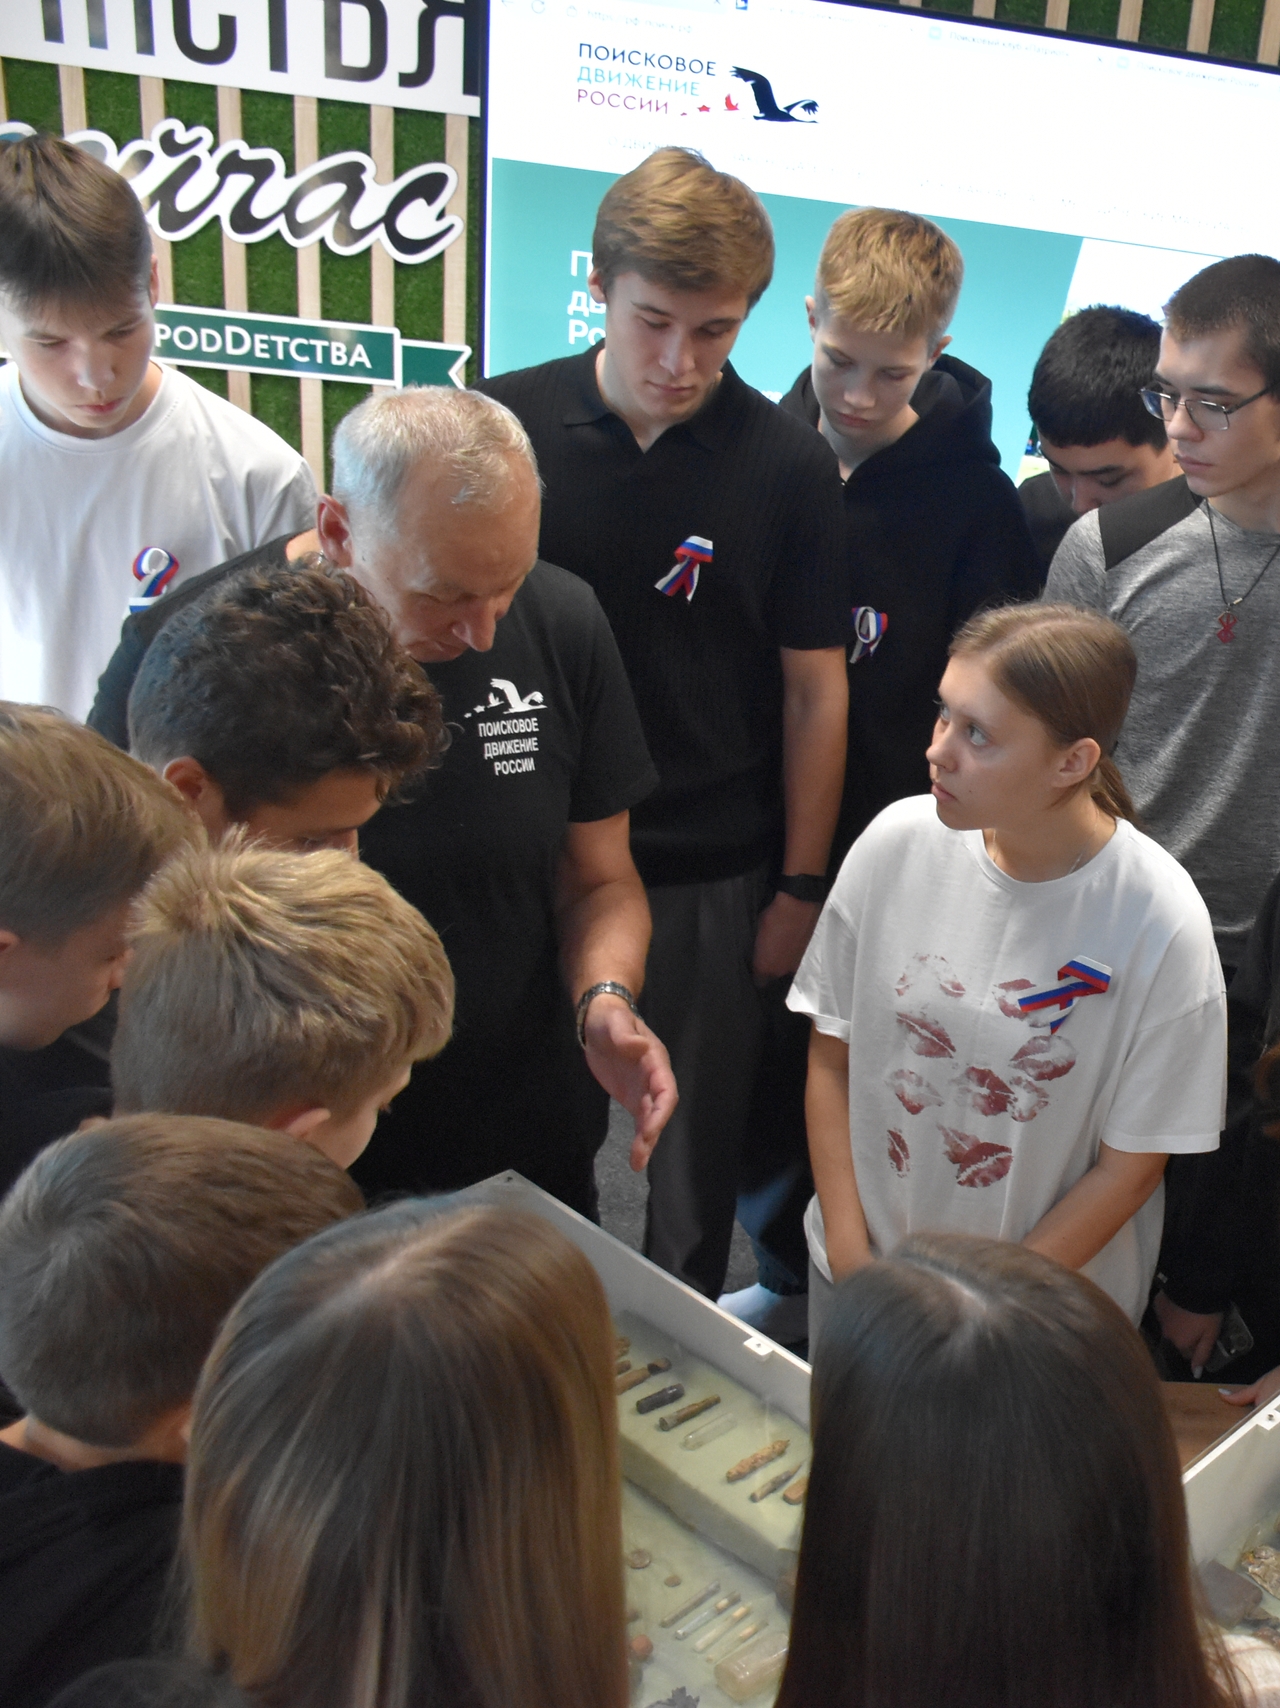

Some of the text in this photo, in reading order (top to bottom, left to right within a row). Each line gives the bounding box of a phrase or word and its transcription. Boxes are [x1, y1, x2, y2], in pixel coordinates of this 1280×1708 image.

[578, 42, 717, 77] ПОИСКОВОЕ
[576, 65, 700, 97] ДВИЖЕНИЕ
[577, 88, 668, 115] РОССИИ
[477, 717, 540, 738] ПОИСКОВОЕ
[483, 736, 540, 760] ДВИЖЕНИЕ
[493, 756, 536, 777] РОССИИ
